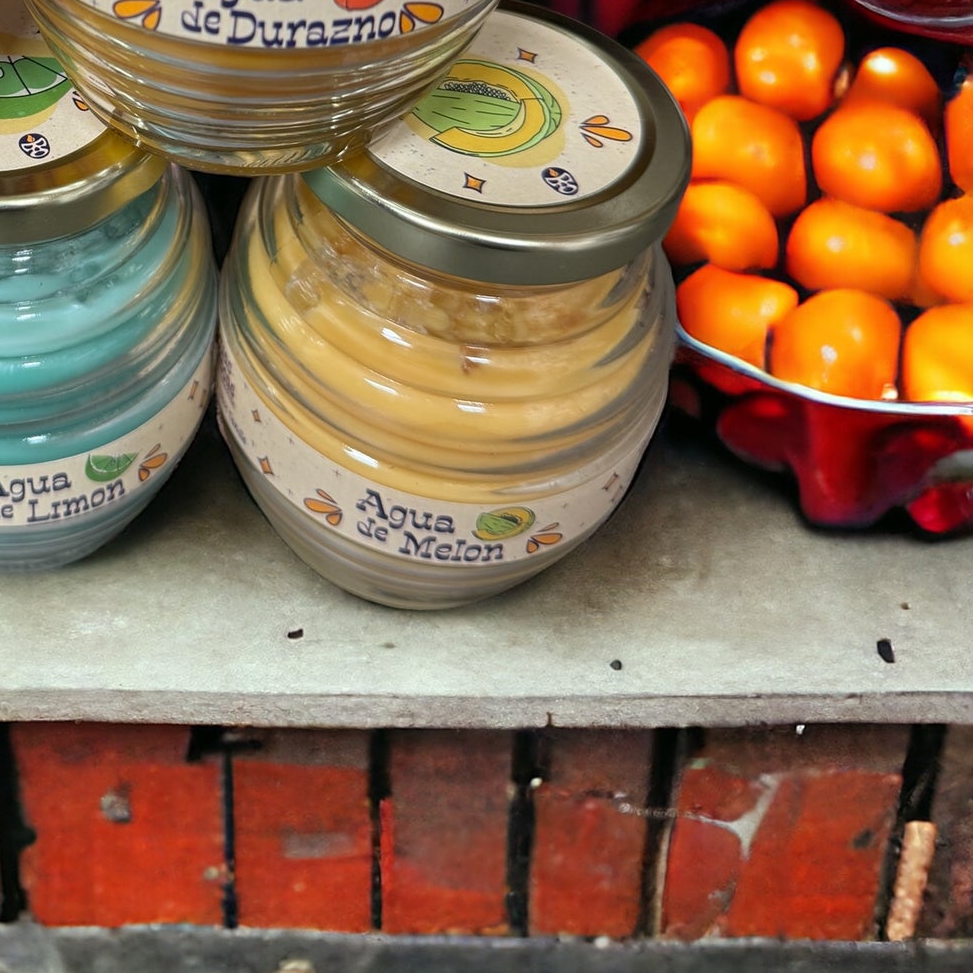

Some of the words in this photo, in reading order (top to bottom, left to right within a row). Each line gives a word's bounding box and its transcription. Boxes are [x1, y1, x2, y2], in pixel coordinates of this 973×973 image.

[181, 0, 221, 34] de
[227, 9, 396, 48] Durazno
[27, 478, 126, 523] Limon
[355, 488, 455, 534] Agua
[356, 516, 388, 542] de
[398, 529, 504, 563] Melon
